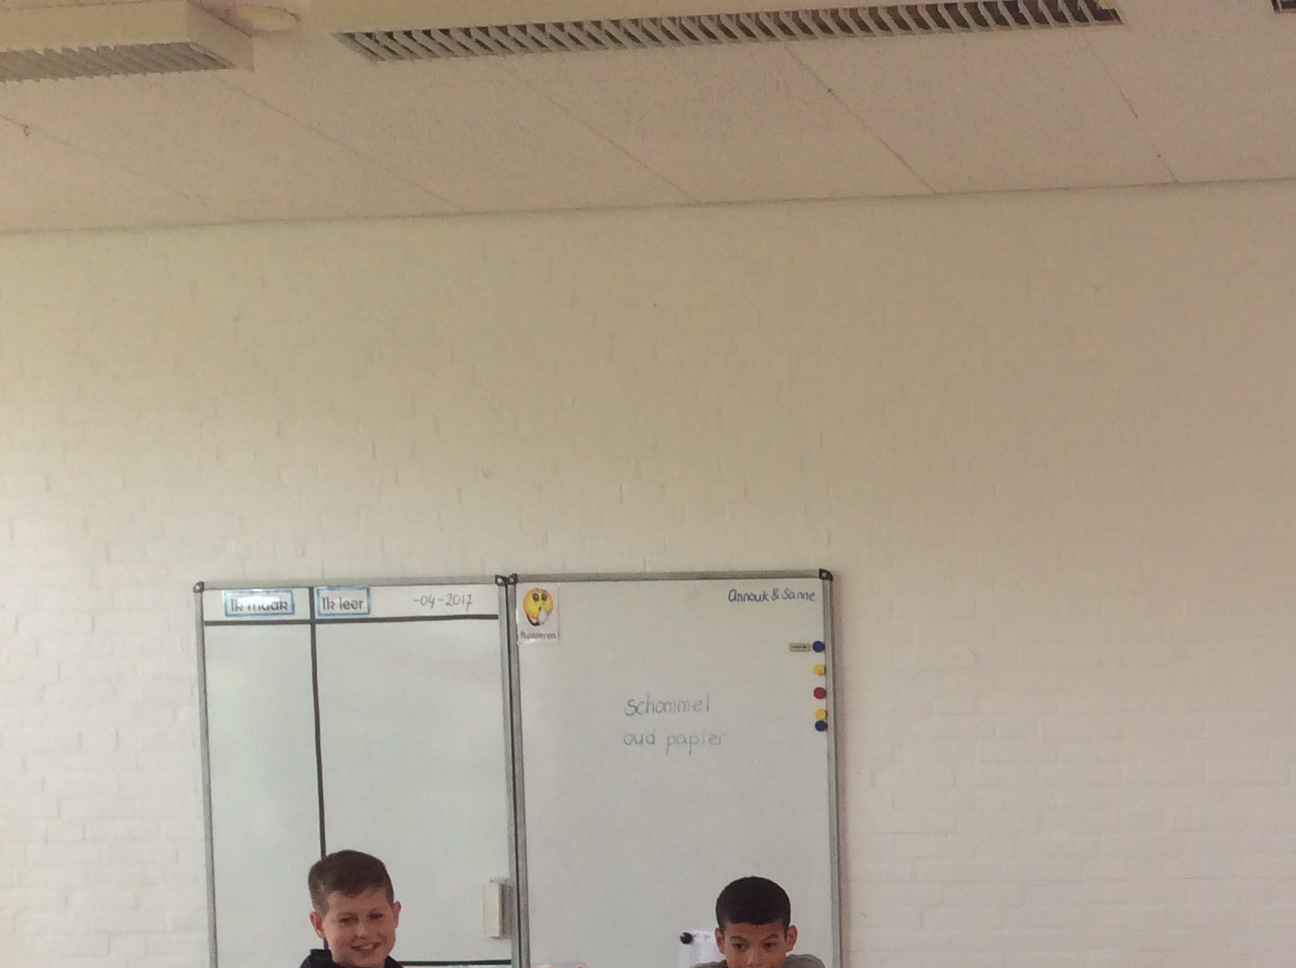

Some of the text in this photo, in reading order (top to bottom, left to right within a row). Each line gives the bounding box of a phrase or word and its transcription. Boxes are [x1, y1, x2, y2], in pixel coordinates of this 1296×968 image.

[781, 588, 815, 601] Sanne
[322, 597, 364, 610] Ik leer
[623, 728, 727, 756] oud papier
